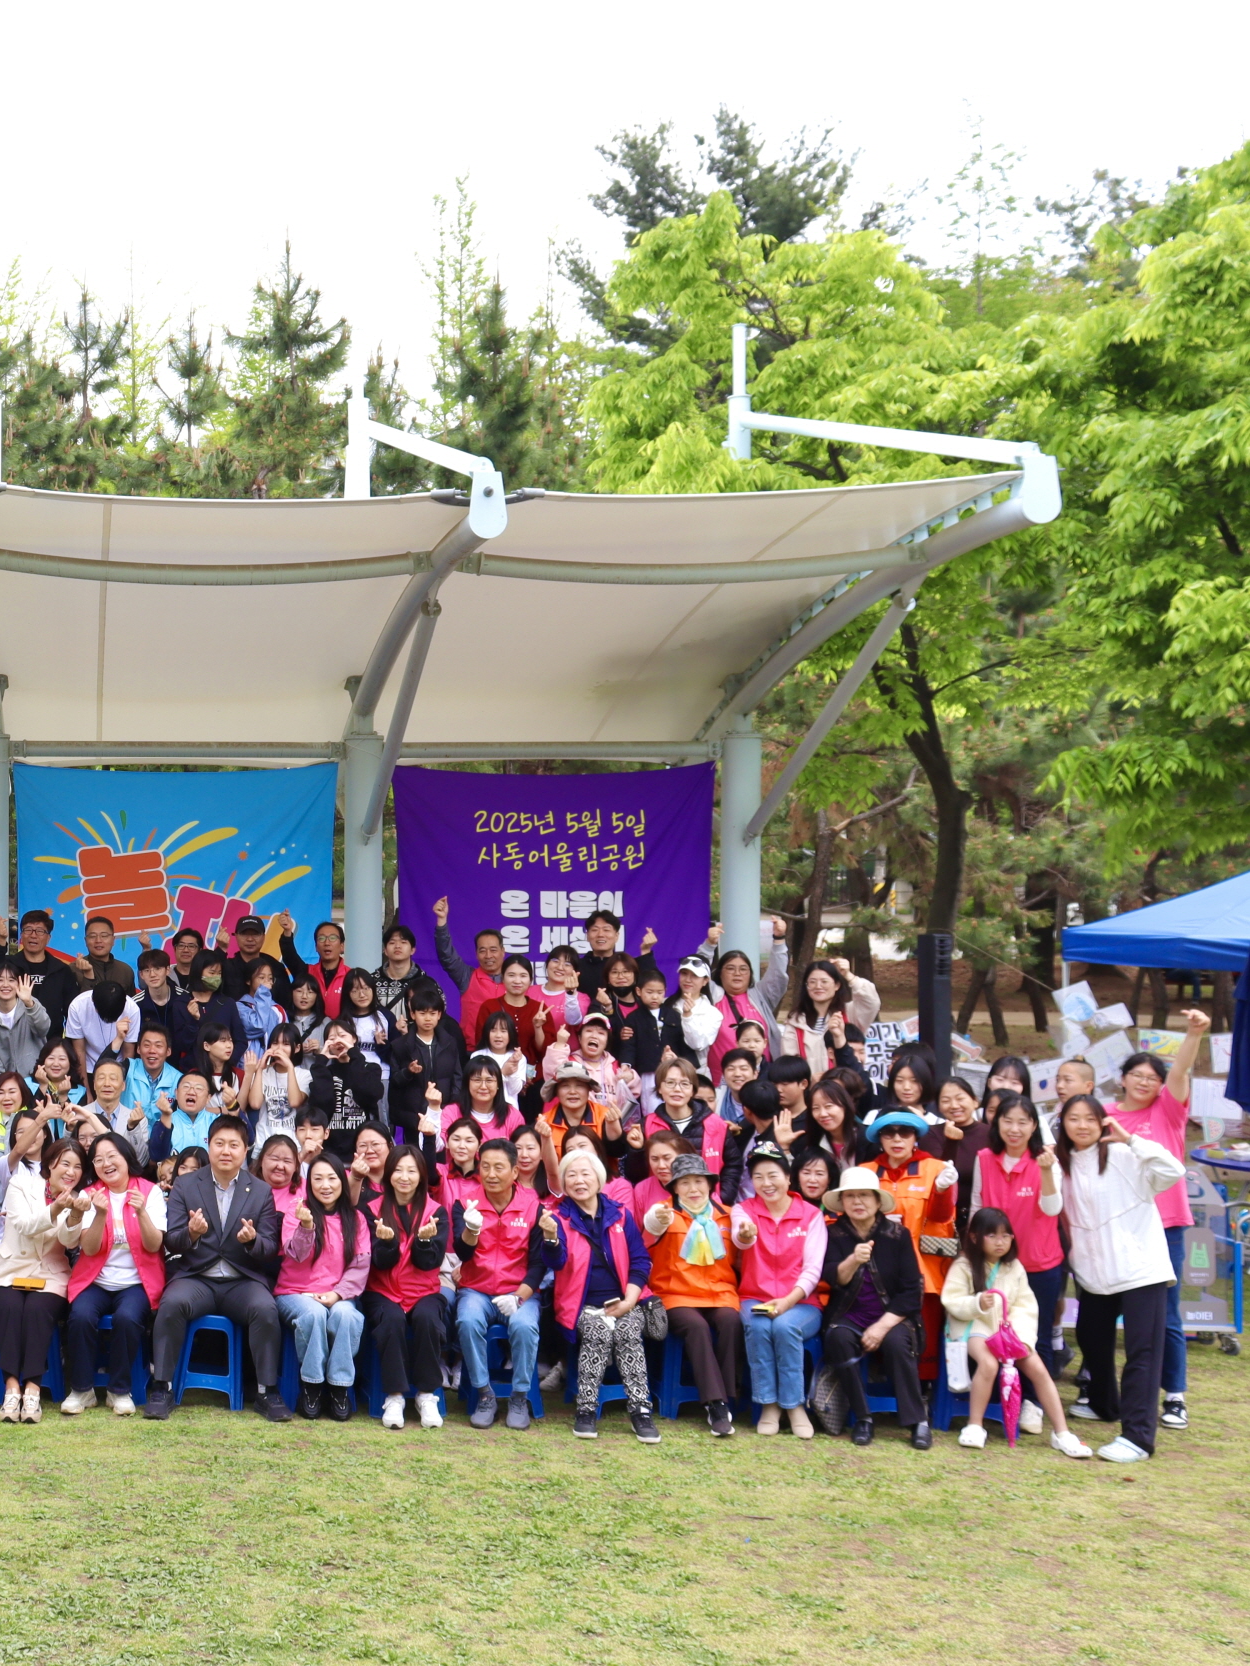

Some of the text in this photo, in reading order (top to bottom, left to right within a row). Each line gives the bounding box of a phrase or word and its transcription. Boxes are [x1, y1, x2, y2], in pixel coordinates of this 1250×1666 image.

[474, 808, 645, 838] 2025년 5월 5일
[477, 841, 645, 873] 사동어울림공원
[500, 889, 624, 919] 온 마을이
[500, 925, 530, 954] 온
